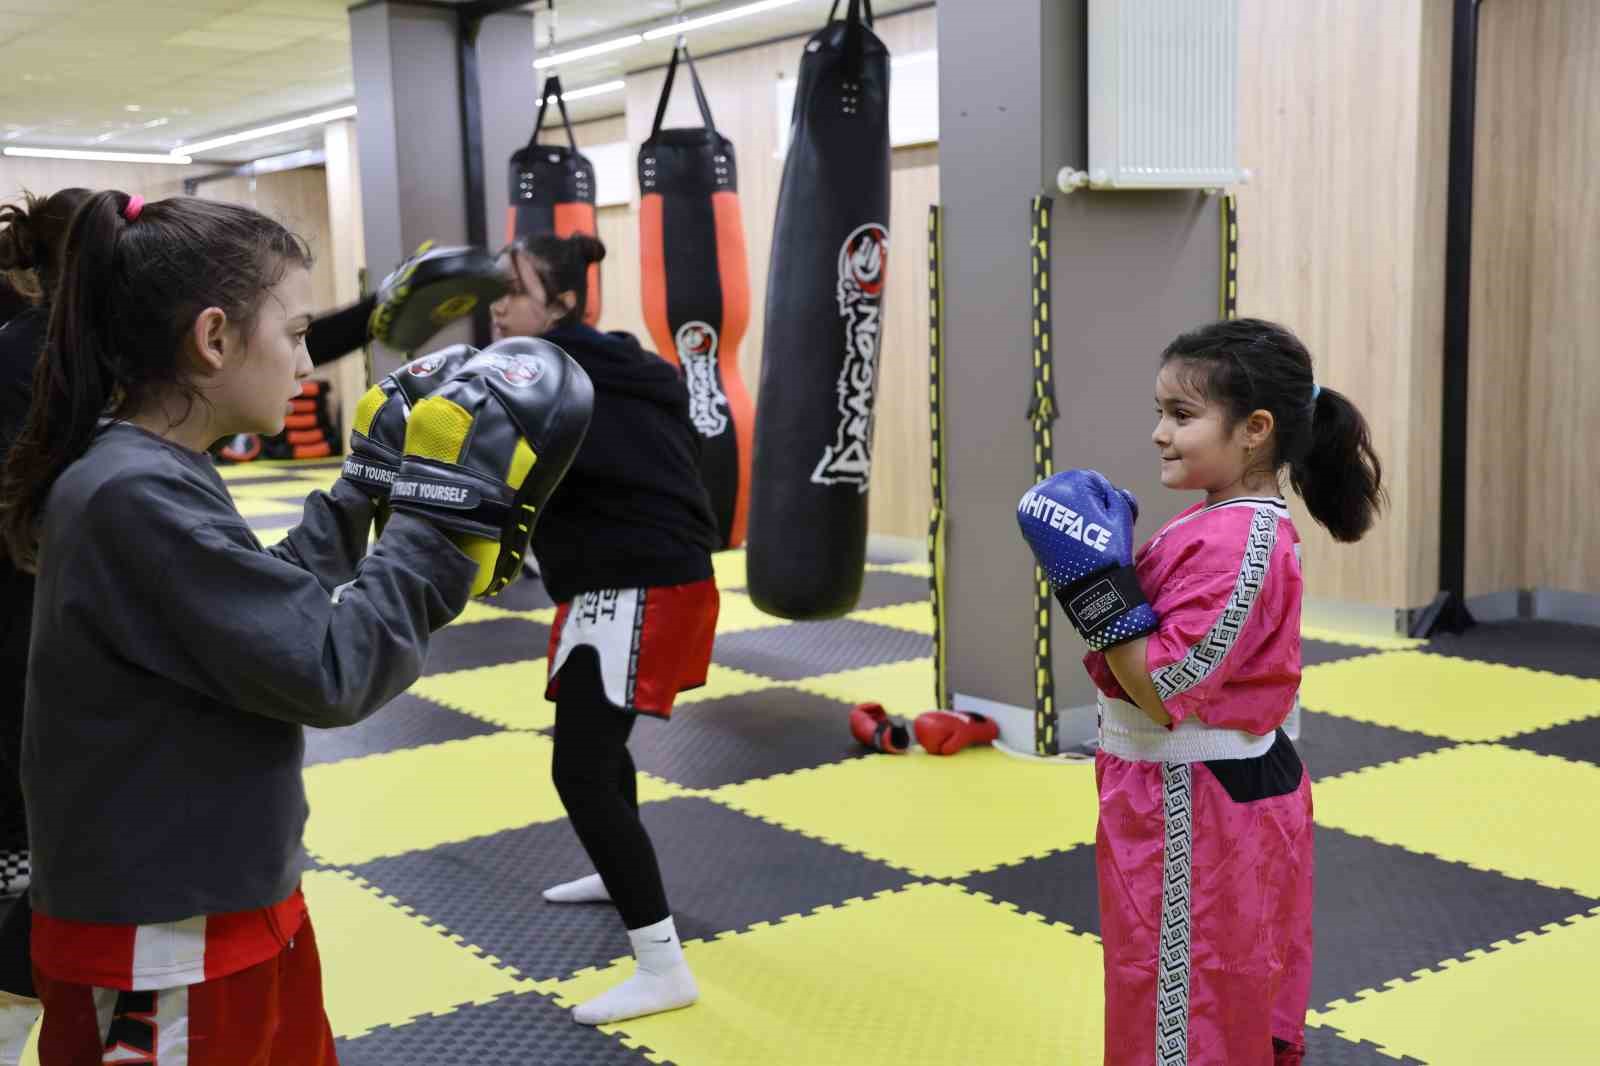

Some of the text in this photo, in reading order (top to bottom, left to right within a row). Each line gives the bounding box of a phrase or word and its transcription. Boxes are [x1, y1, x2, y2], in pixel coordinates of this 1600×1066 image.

[824, 303, 880, 484] DRAGON
[365, 465, 399, 483] YOURSE
[391, 481, 468, 502] TRUST YOURSELF
[1018, 490, 1113, 552] WHITEFACE
